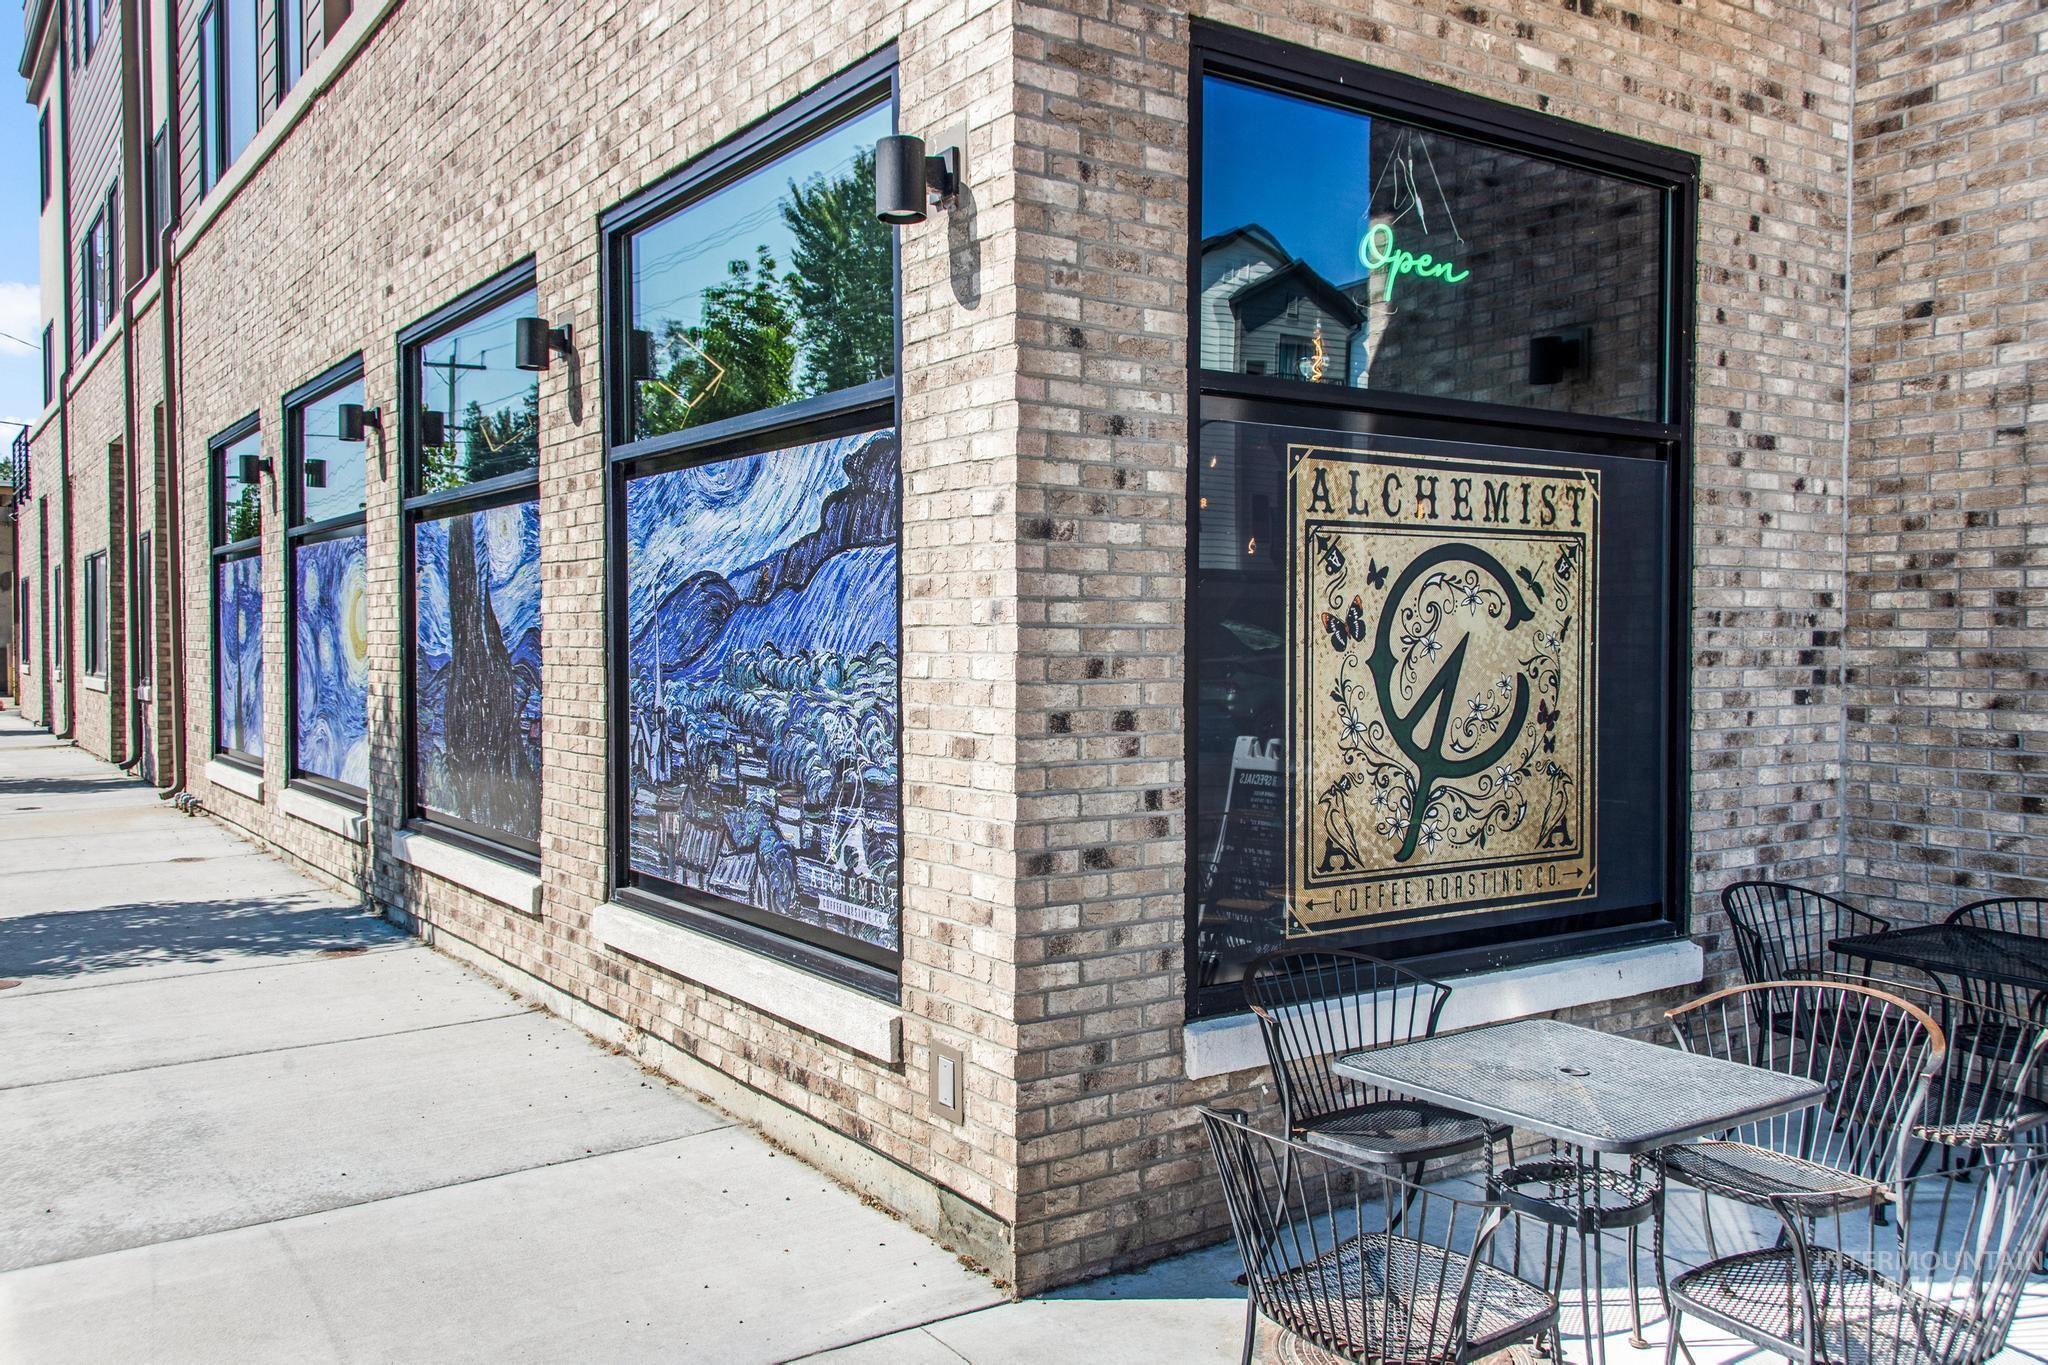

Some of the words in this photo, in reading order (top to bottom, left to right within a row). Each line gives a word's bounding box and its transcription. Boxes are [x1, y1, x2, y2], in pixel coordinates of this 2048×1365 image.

[1359, 223, 1469, 302] Open
[1306, 467, 1586, 527] ALCHEMIST
[834, 817, 872, 875] A
[810, 868, 898, 909] ALCHEMIST
[1334, 880, 1412, 913] COFFEE
[1427, 869, 1524, 899] ROASTING
[1536, 865, 1561, 888] CO.
